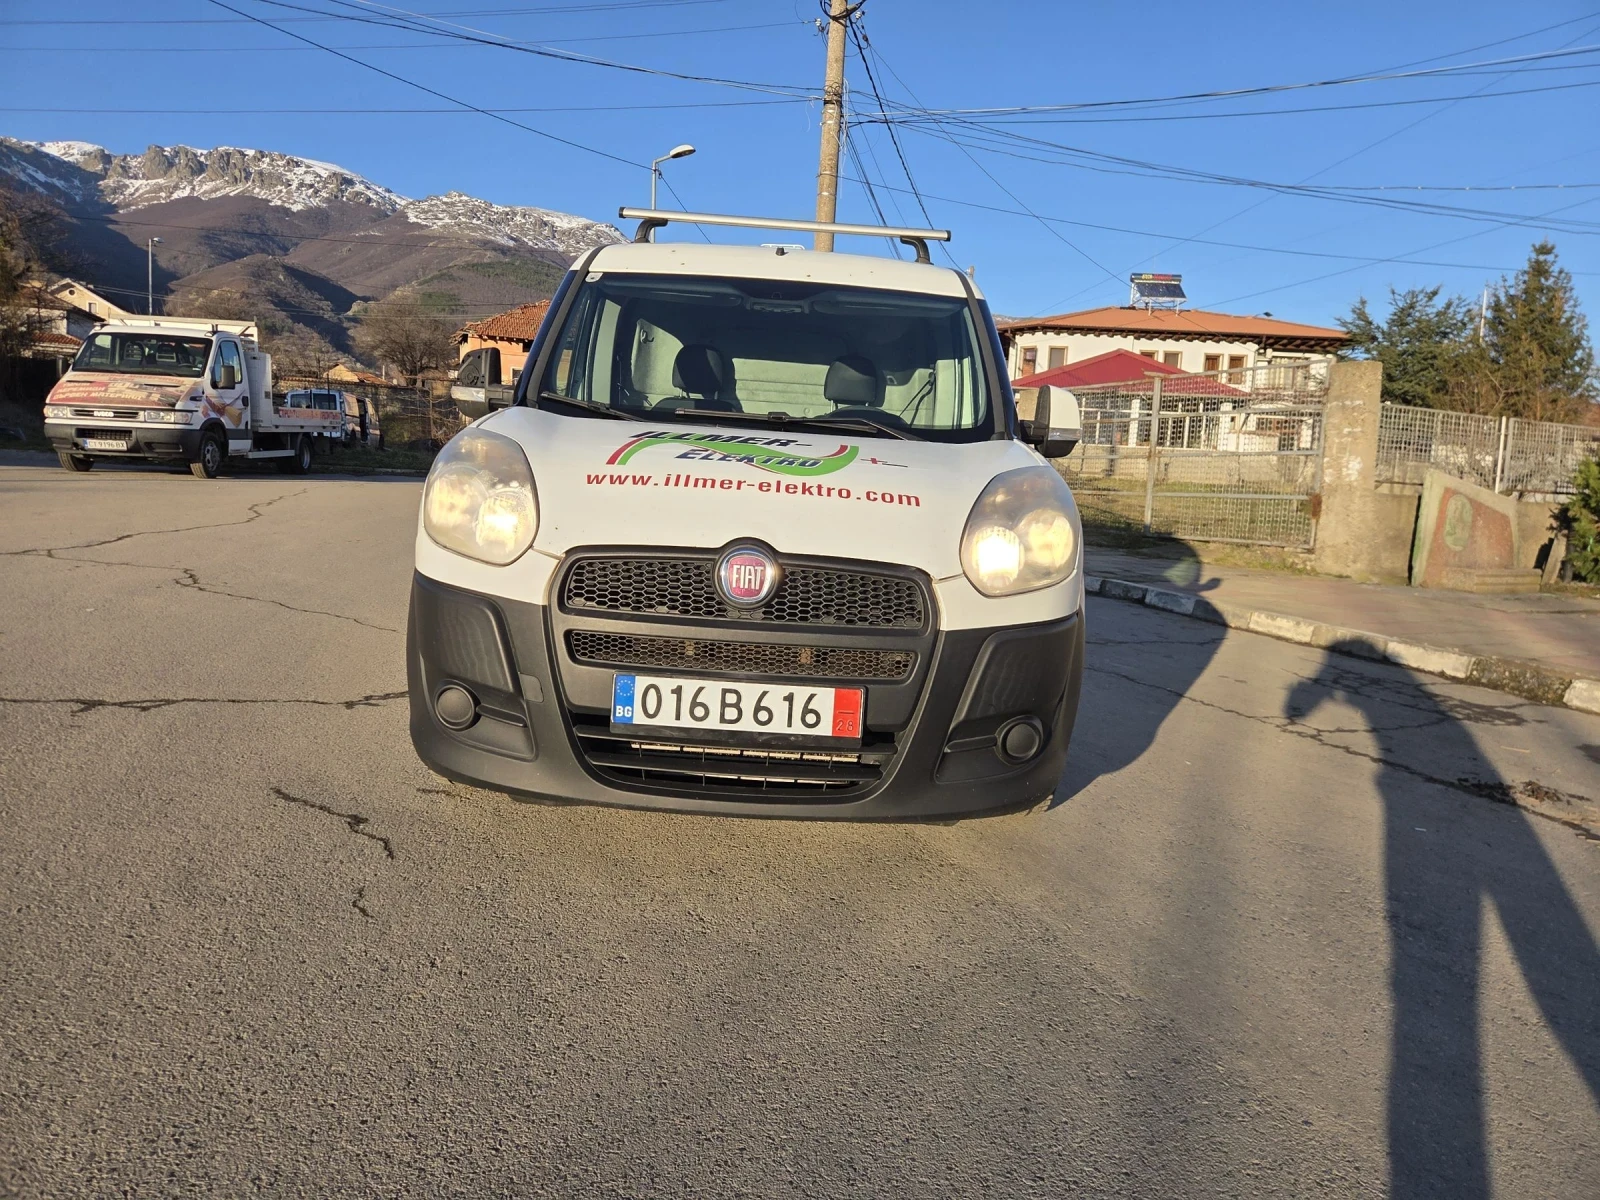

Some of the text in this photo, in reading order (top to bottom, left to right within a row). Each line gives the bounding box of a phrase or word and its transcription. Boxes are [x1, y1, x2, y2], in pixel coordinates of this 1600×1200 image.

[674, 447, 823, 468] ELEKTRO
[586, 472, 921, 508] www.illmer-elektro.com
[732, 564, 765, 590] FIAT
[615, 705, 632, 718] BG
[836, 719, 854, 732] 28
